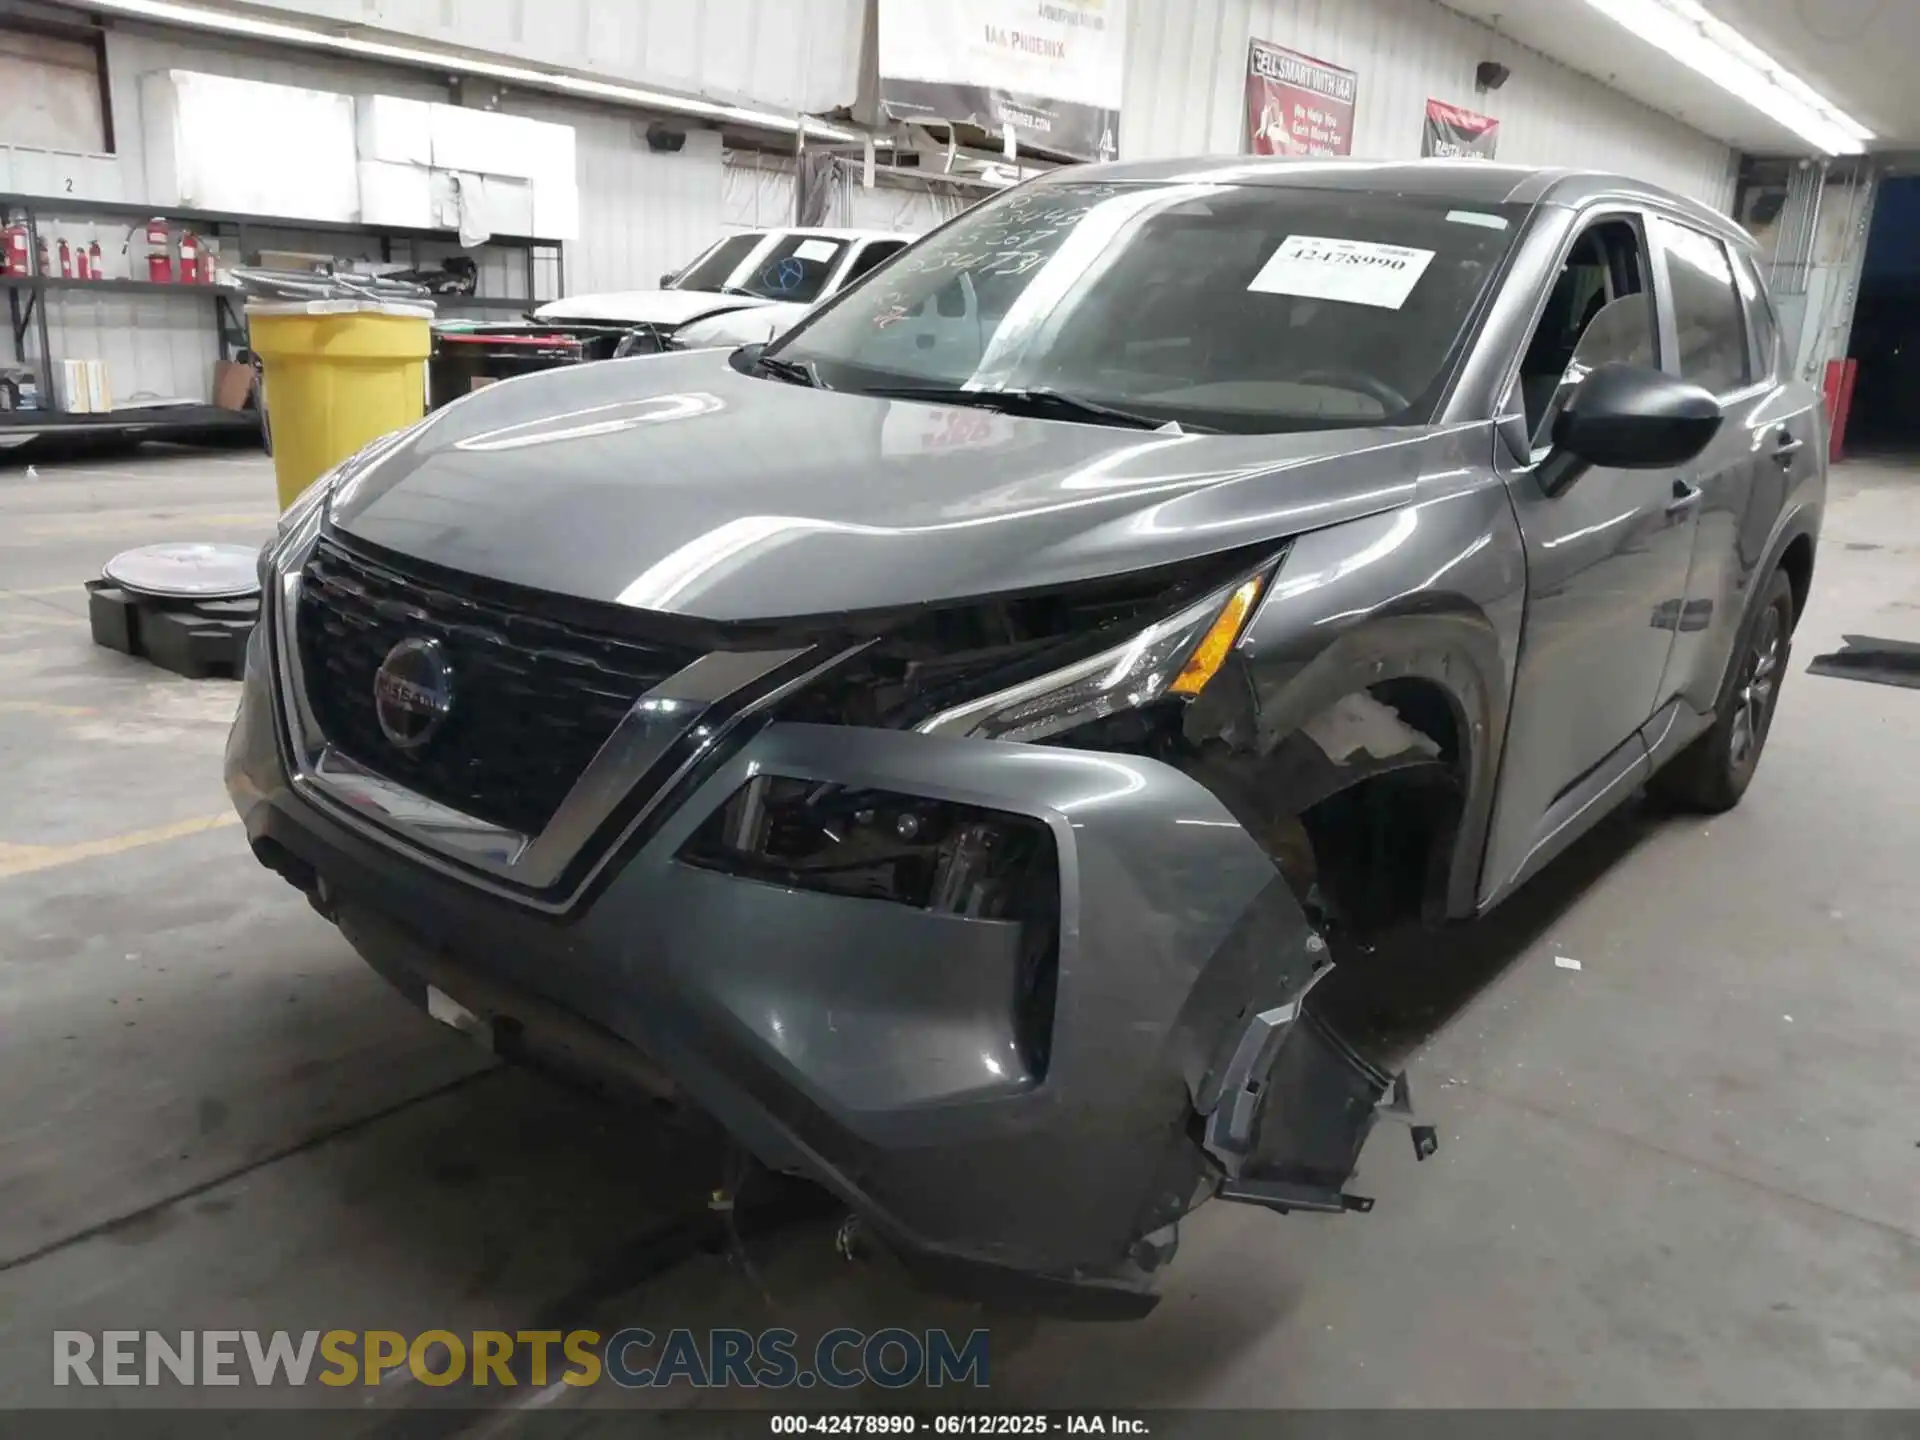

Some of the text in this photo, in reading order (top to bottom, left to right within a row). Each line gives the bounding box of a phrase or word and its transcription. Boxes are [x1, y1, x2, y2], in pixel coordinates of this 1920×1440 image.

[985, 24, 1008, 48] IAA
[65, 178, 73, 192] 2
[1290, 248, 1406, 271] 42478990
